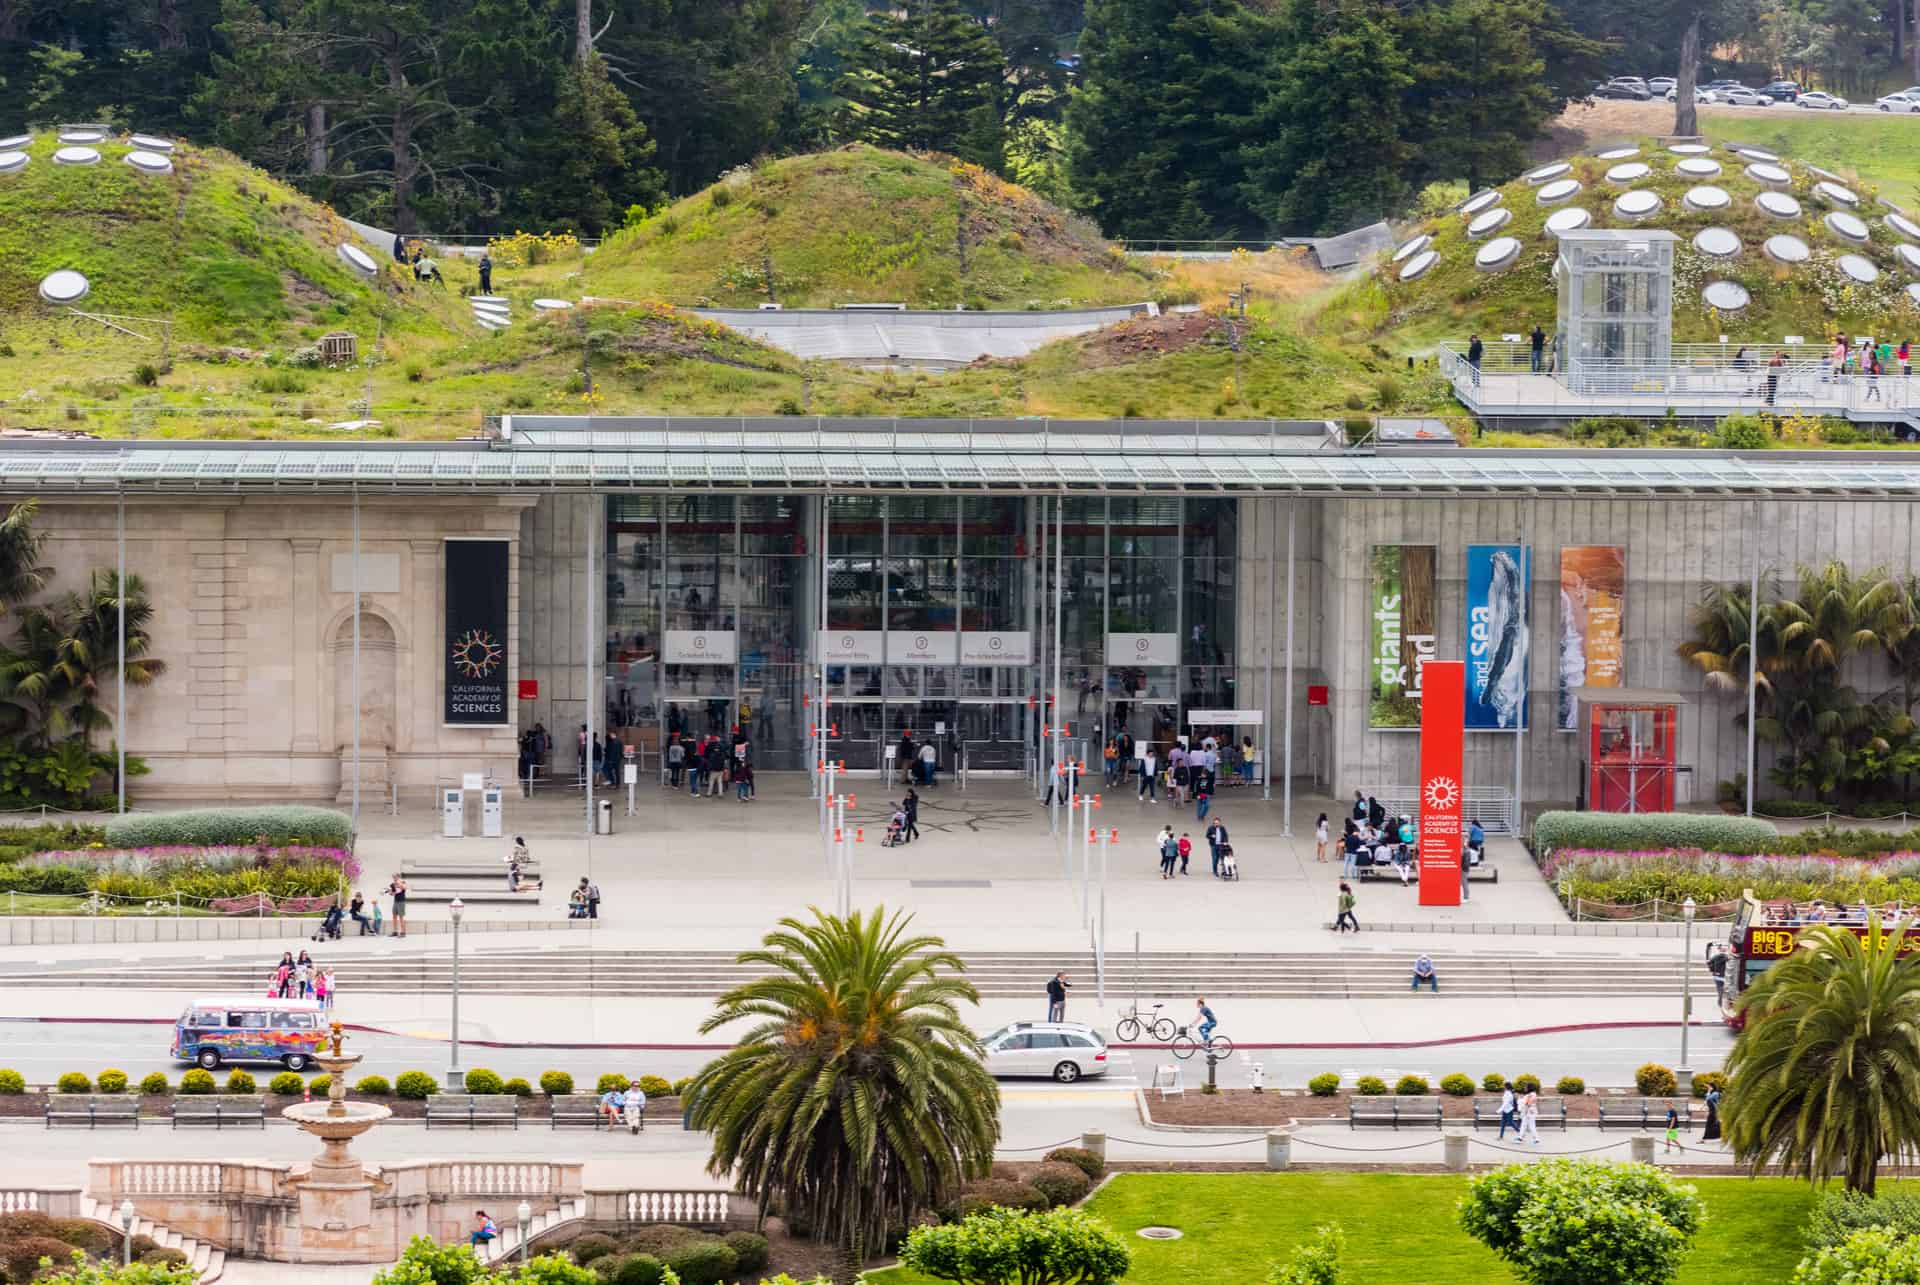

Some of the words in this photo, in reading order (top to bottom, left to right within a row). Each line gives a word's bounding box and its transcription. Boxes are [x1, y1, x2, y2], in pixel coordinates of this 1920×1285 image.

[1470, 607, 1489, 655] sea
[1374, 595, 1406, 685] giants
[452, 685, 501, 693] CALIFORNIA
[452, 704, 501, 713] SCIENCES
[1753, 930, 1775, 943] BIG
[1752, 943, 1776, 954] BUS
